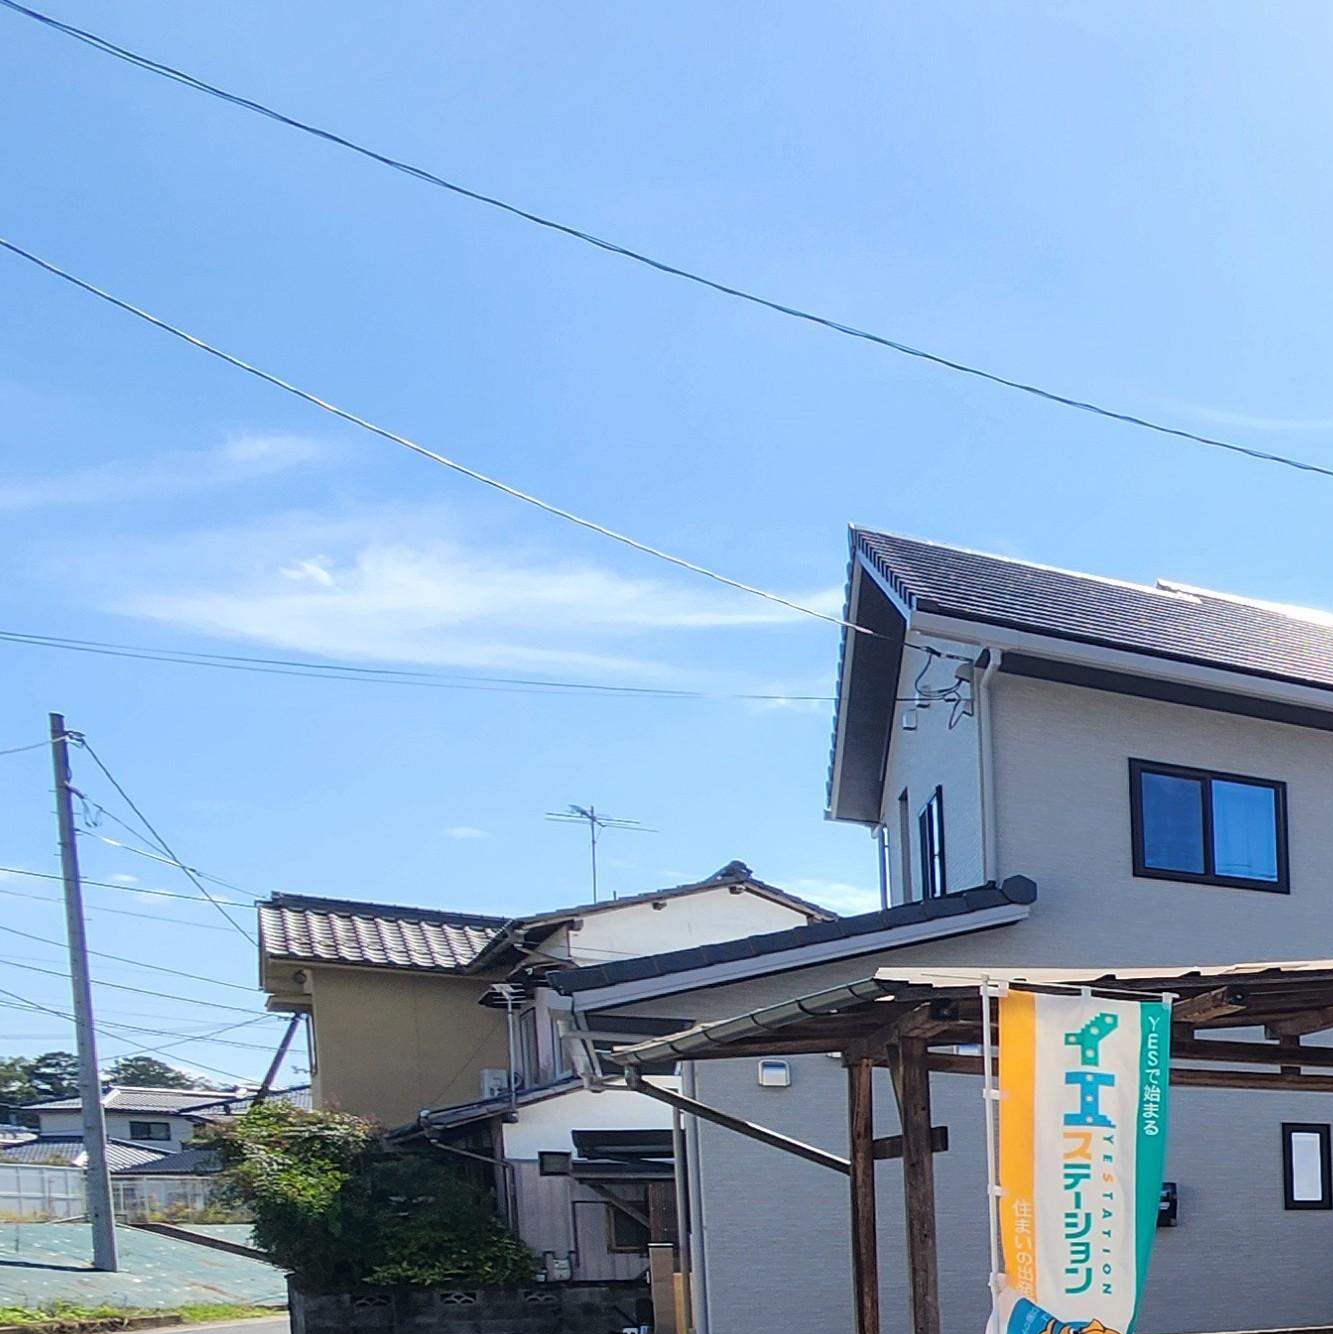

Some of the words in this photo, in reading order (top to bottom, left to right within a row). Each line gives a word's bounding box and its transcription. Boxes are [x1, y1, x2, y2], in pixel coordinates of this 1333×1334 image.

[1063, 1012, 1118, 1295] イエステーション
[1101, 1134, 1115, 1296] YESTATION
